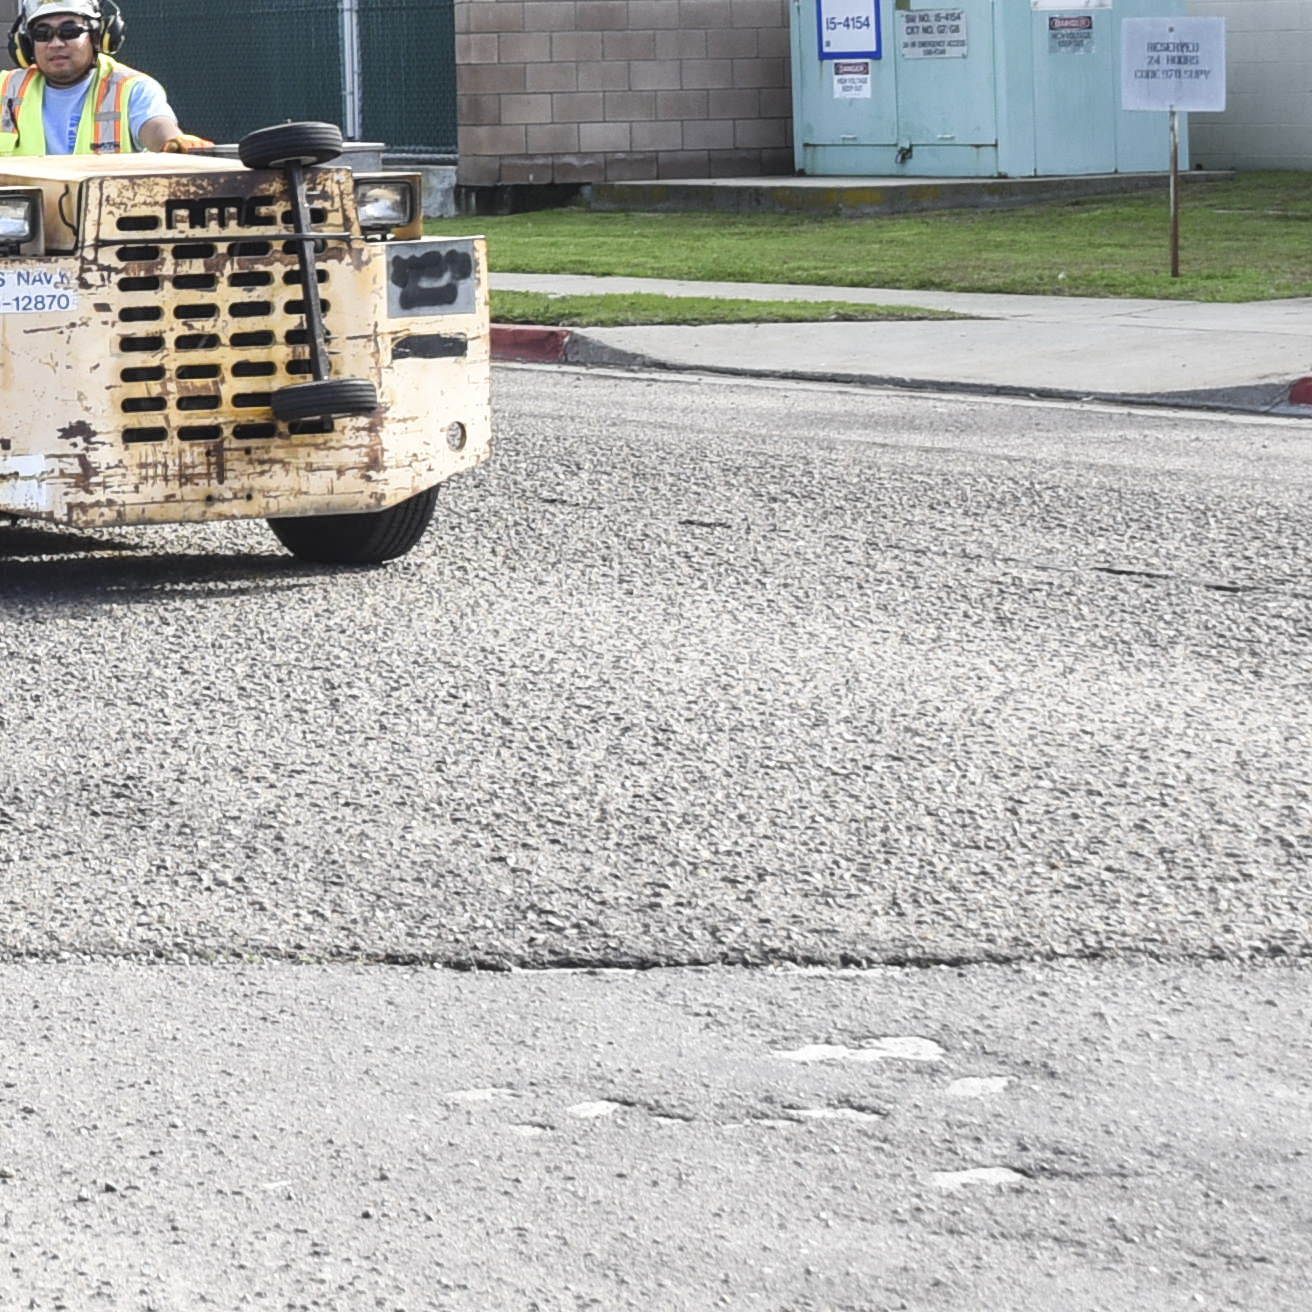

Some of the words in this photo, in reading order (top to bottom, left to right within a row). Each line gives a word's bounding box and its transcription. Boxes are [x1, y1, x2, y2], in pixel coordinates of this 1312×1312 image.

[1146, 41, 1200, 53] RESERVED
[1166, 55, 1200, 65] HOURS
[17, 270, 69, 286] NAVY
